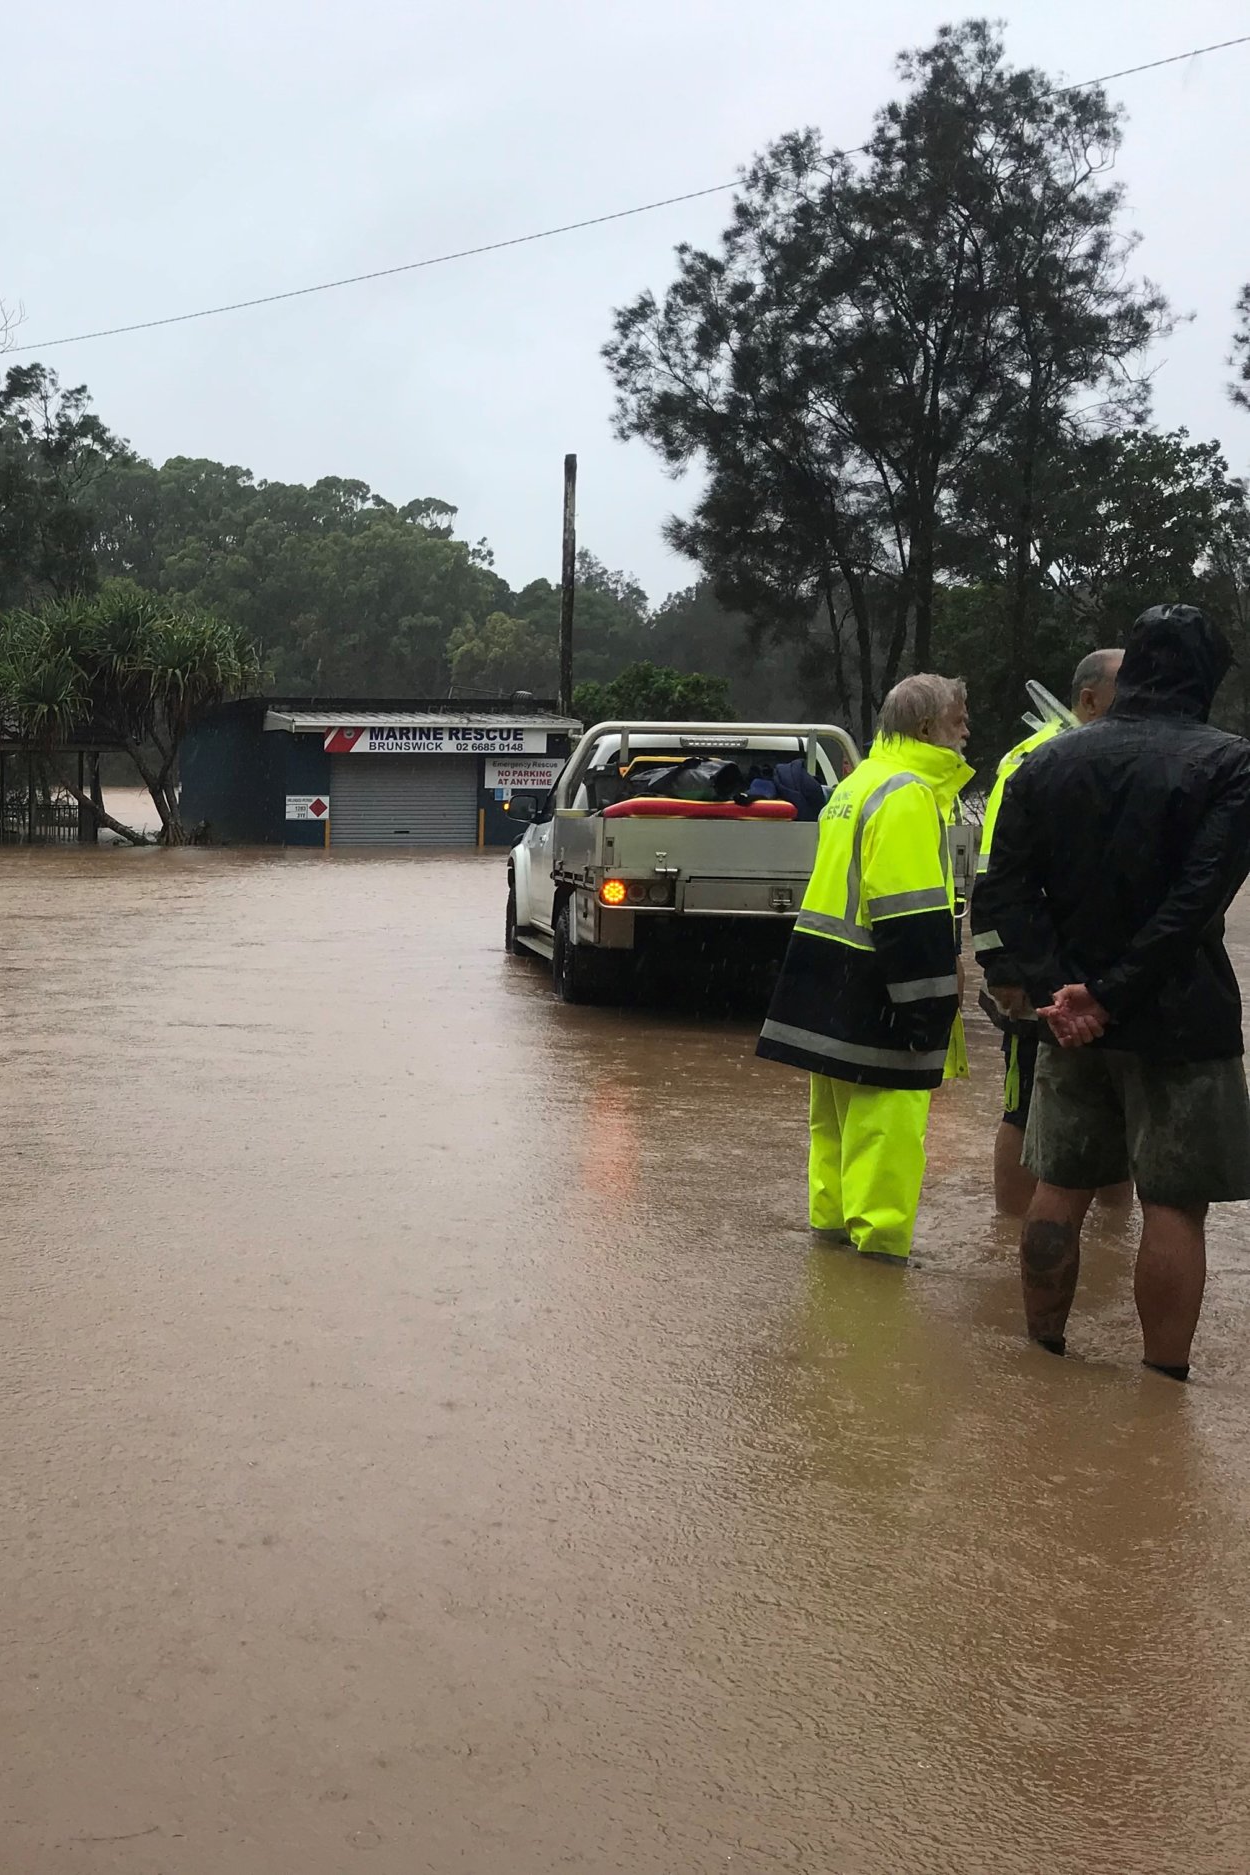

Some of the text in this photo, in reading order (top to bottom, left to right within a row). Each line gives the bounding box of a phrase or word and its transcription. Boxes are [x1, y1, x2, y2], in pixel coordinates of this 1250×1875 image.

[369, 727, 524, 741] MARINE RESCUE
[369, 742, 443, 751] BRUNSWICK
[456, 743, 524, 752] 02 6685 0148
[492, 761, 532, 769] Emergency
